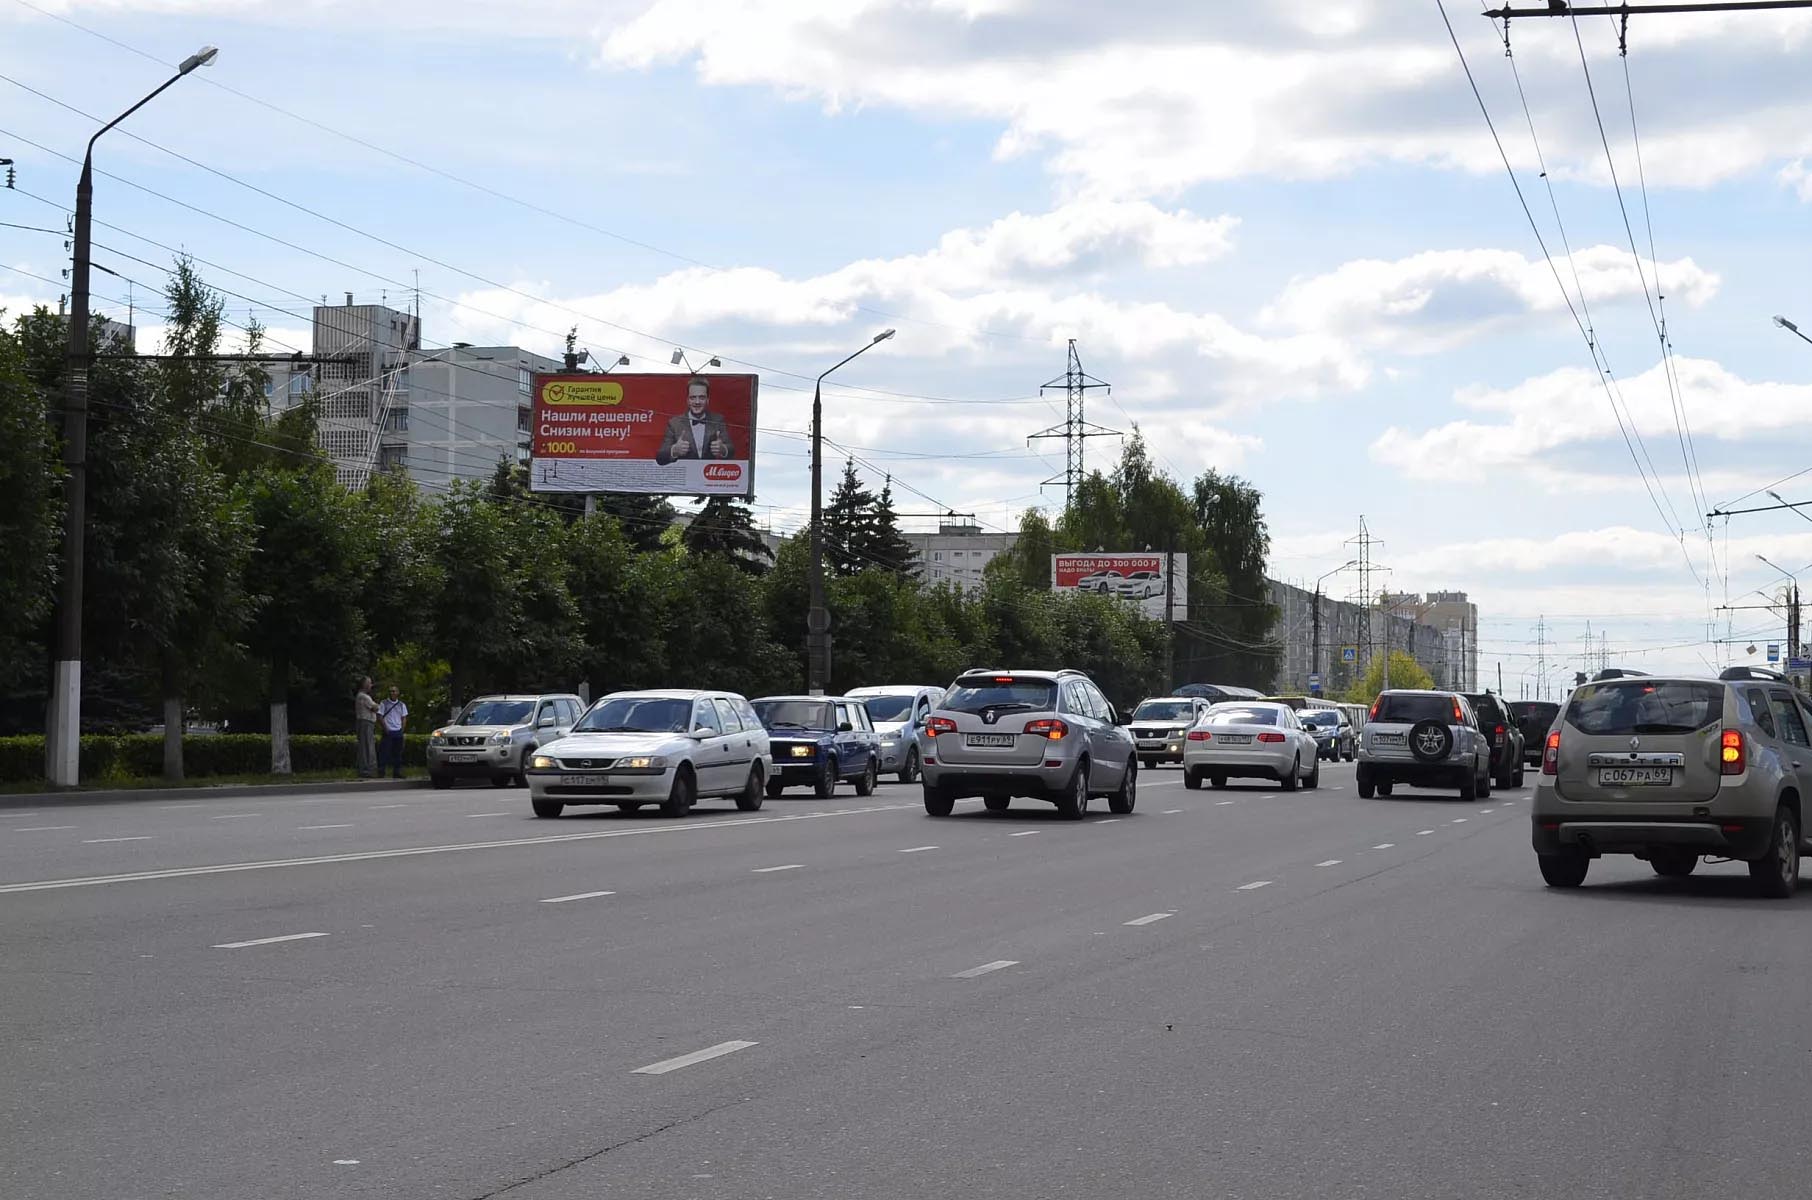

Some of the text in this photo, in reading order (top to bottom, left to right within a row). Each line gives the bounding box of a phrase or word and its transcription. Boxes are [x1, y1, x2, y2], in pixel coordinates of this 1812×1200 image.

[567, 386, 602, 394] Гарантия
[596, 394, 617, 402] цены
[541, 410, 654, 424] Нашли дешевле?
[540, 424, 631, 441] Снизим цену!
[1604, 769, 1668, 781] С067РА 69
